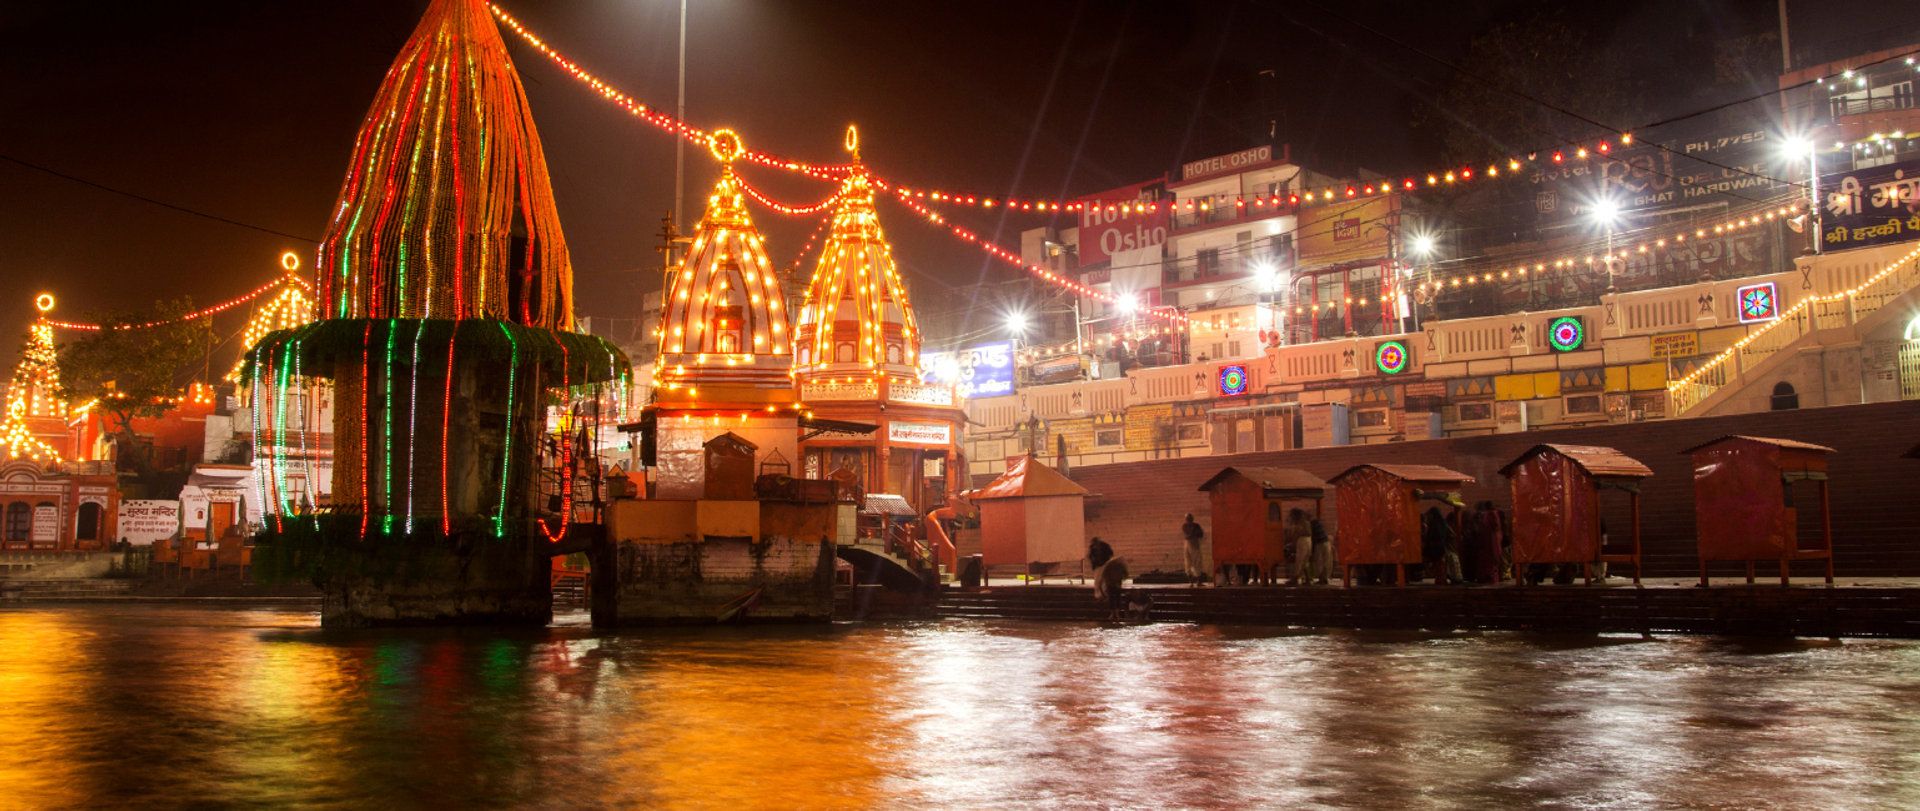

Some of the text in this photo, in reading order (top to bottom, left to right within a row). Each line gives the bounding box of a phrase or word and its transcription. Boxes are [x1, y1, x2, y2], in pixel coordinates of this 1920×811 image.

[1186, 147, 1269, 178] HOTEL OSHO
[1634, 191, 1675, 207] GHAT
